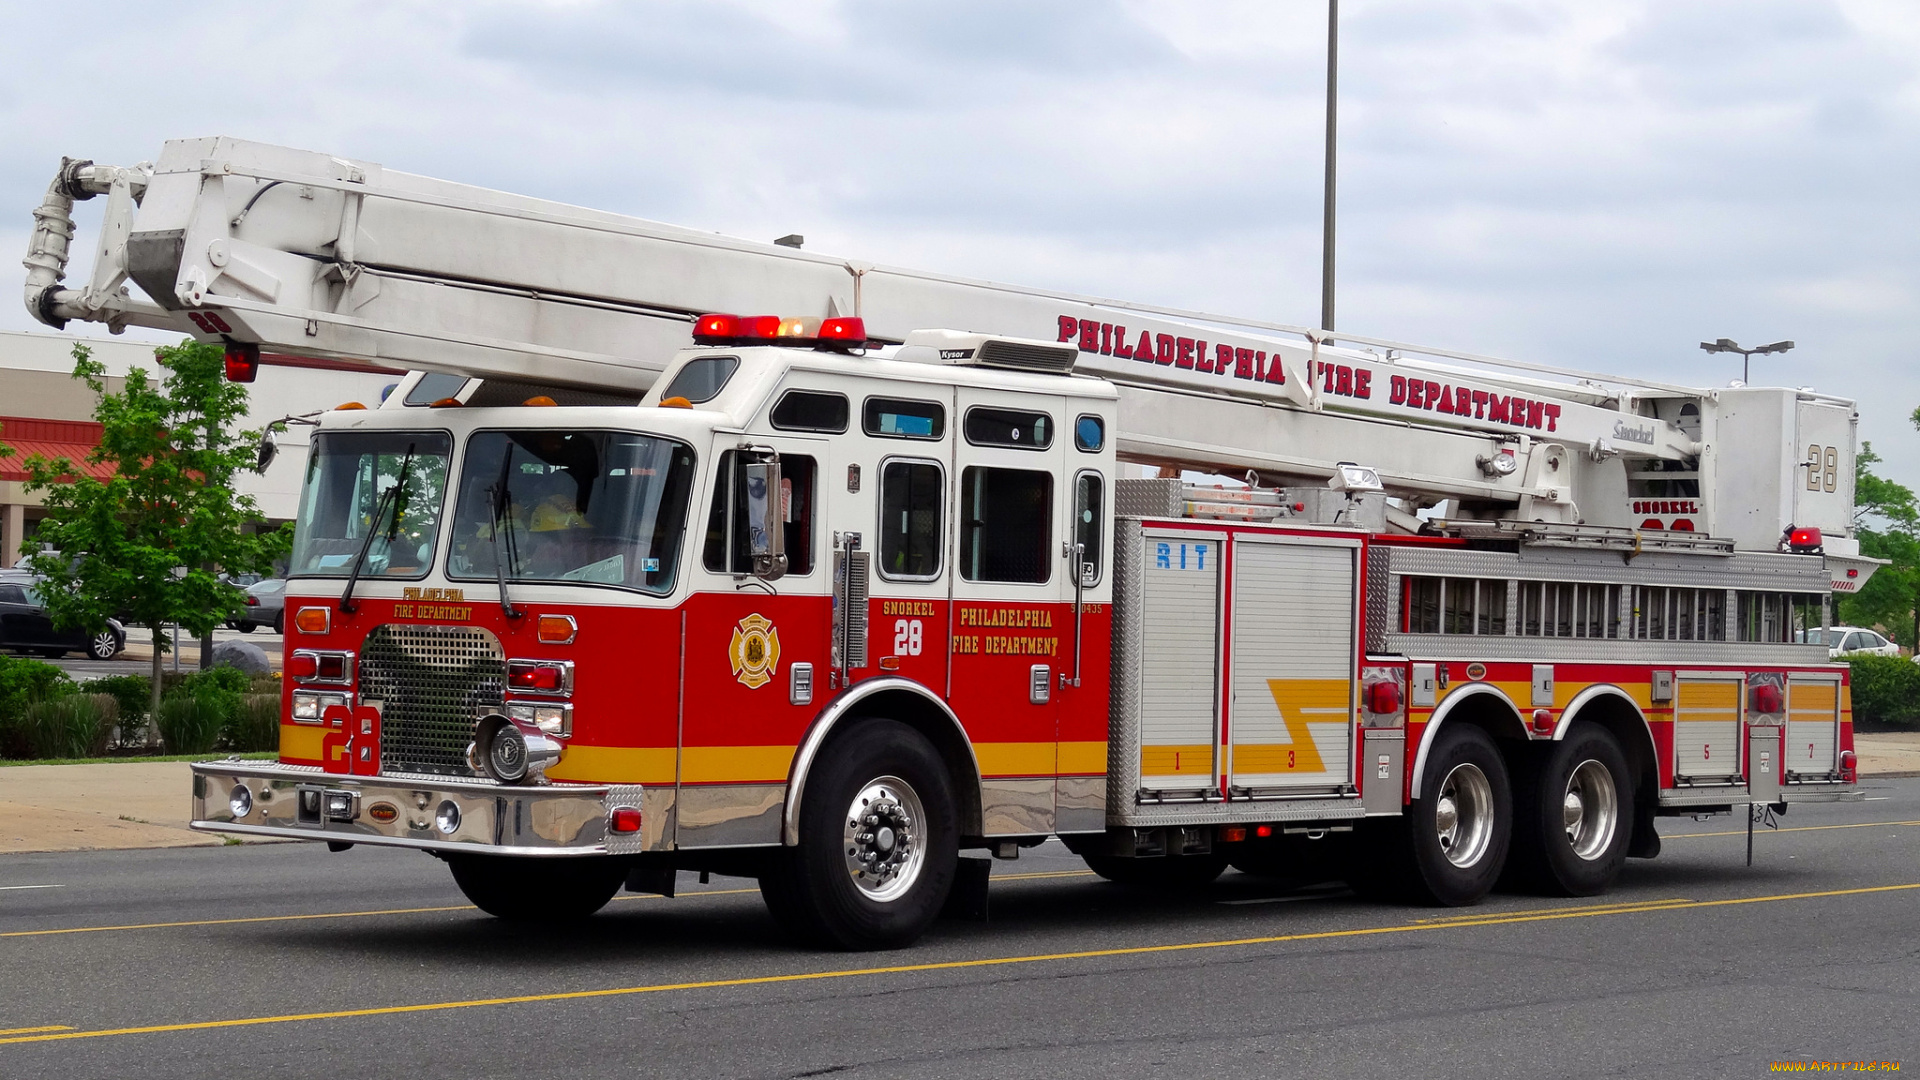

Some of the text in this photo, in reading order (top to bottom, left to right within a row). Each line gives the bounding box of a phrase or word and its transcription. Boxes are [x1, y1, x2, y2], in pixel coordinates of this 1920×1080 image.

[942, 351, 964, 360] Kysor
[1057, 315, 1286, 385] PHILADELPHIA
[1389, 374, 1561, 432] DEPARTMENT
[1807, 444, 1838, 493] 28
[1633, 501, 1698, 514] SNORKEL
[1157, 543, 1208, 570] RIT
[403, 587, 464, 602] PHILADELPHIA
[394, 604, 472, 620] FIRE DEPARTMENT
[883, 601, 935, 616] SNORKEL
[1071, 604, 1102, 614] 90435
[960, 608, 1053, 628] PHILADELPHIA
[894, 619, 923, 656] 28
[952, 636, 1058, 657] FIRE DEPARTMENT
[322, 704, 382, 777] 28
[1288, 750, 1295, 768] 3
[1704, 744, 1710, 760] 5
[1808, 743, 1814, 758] 7
[1175, 752, 1179, 770] 1
